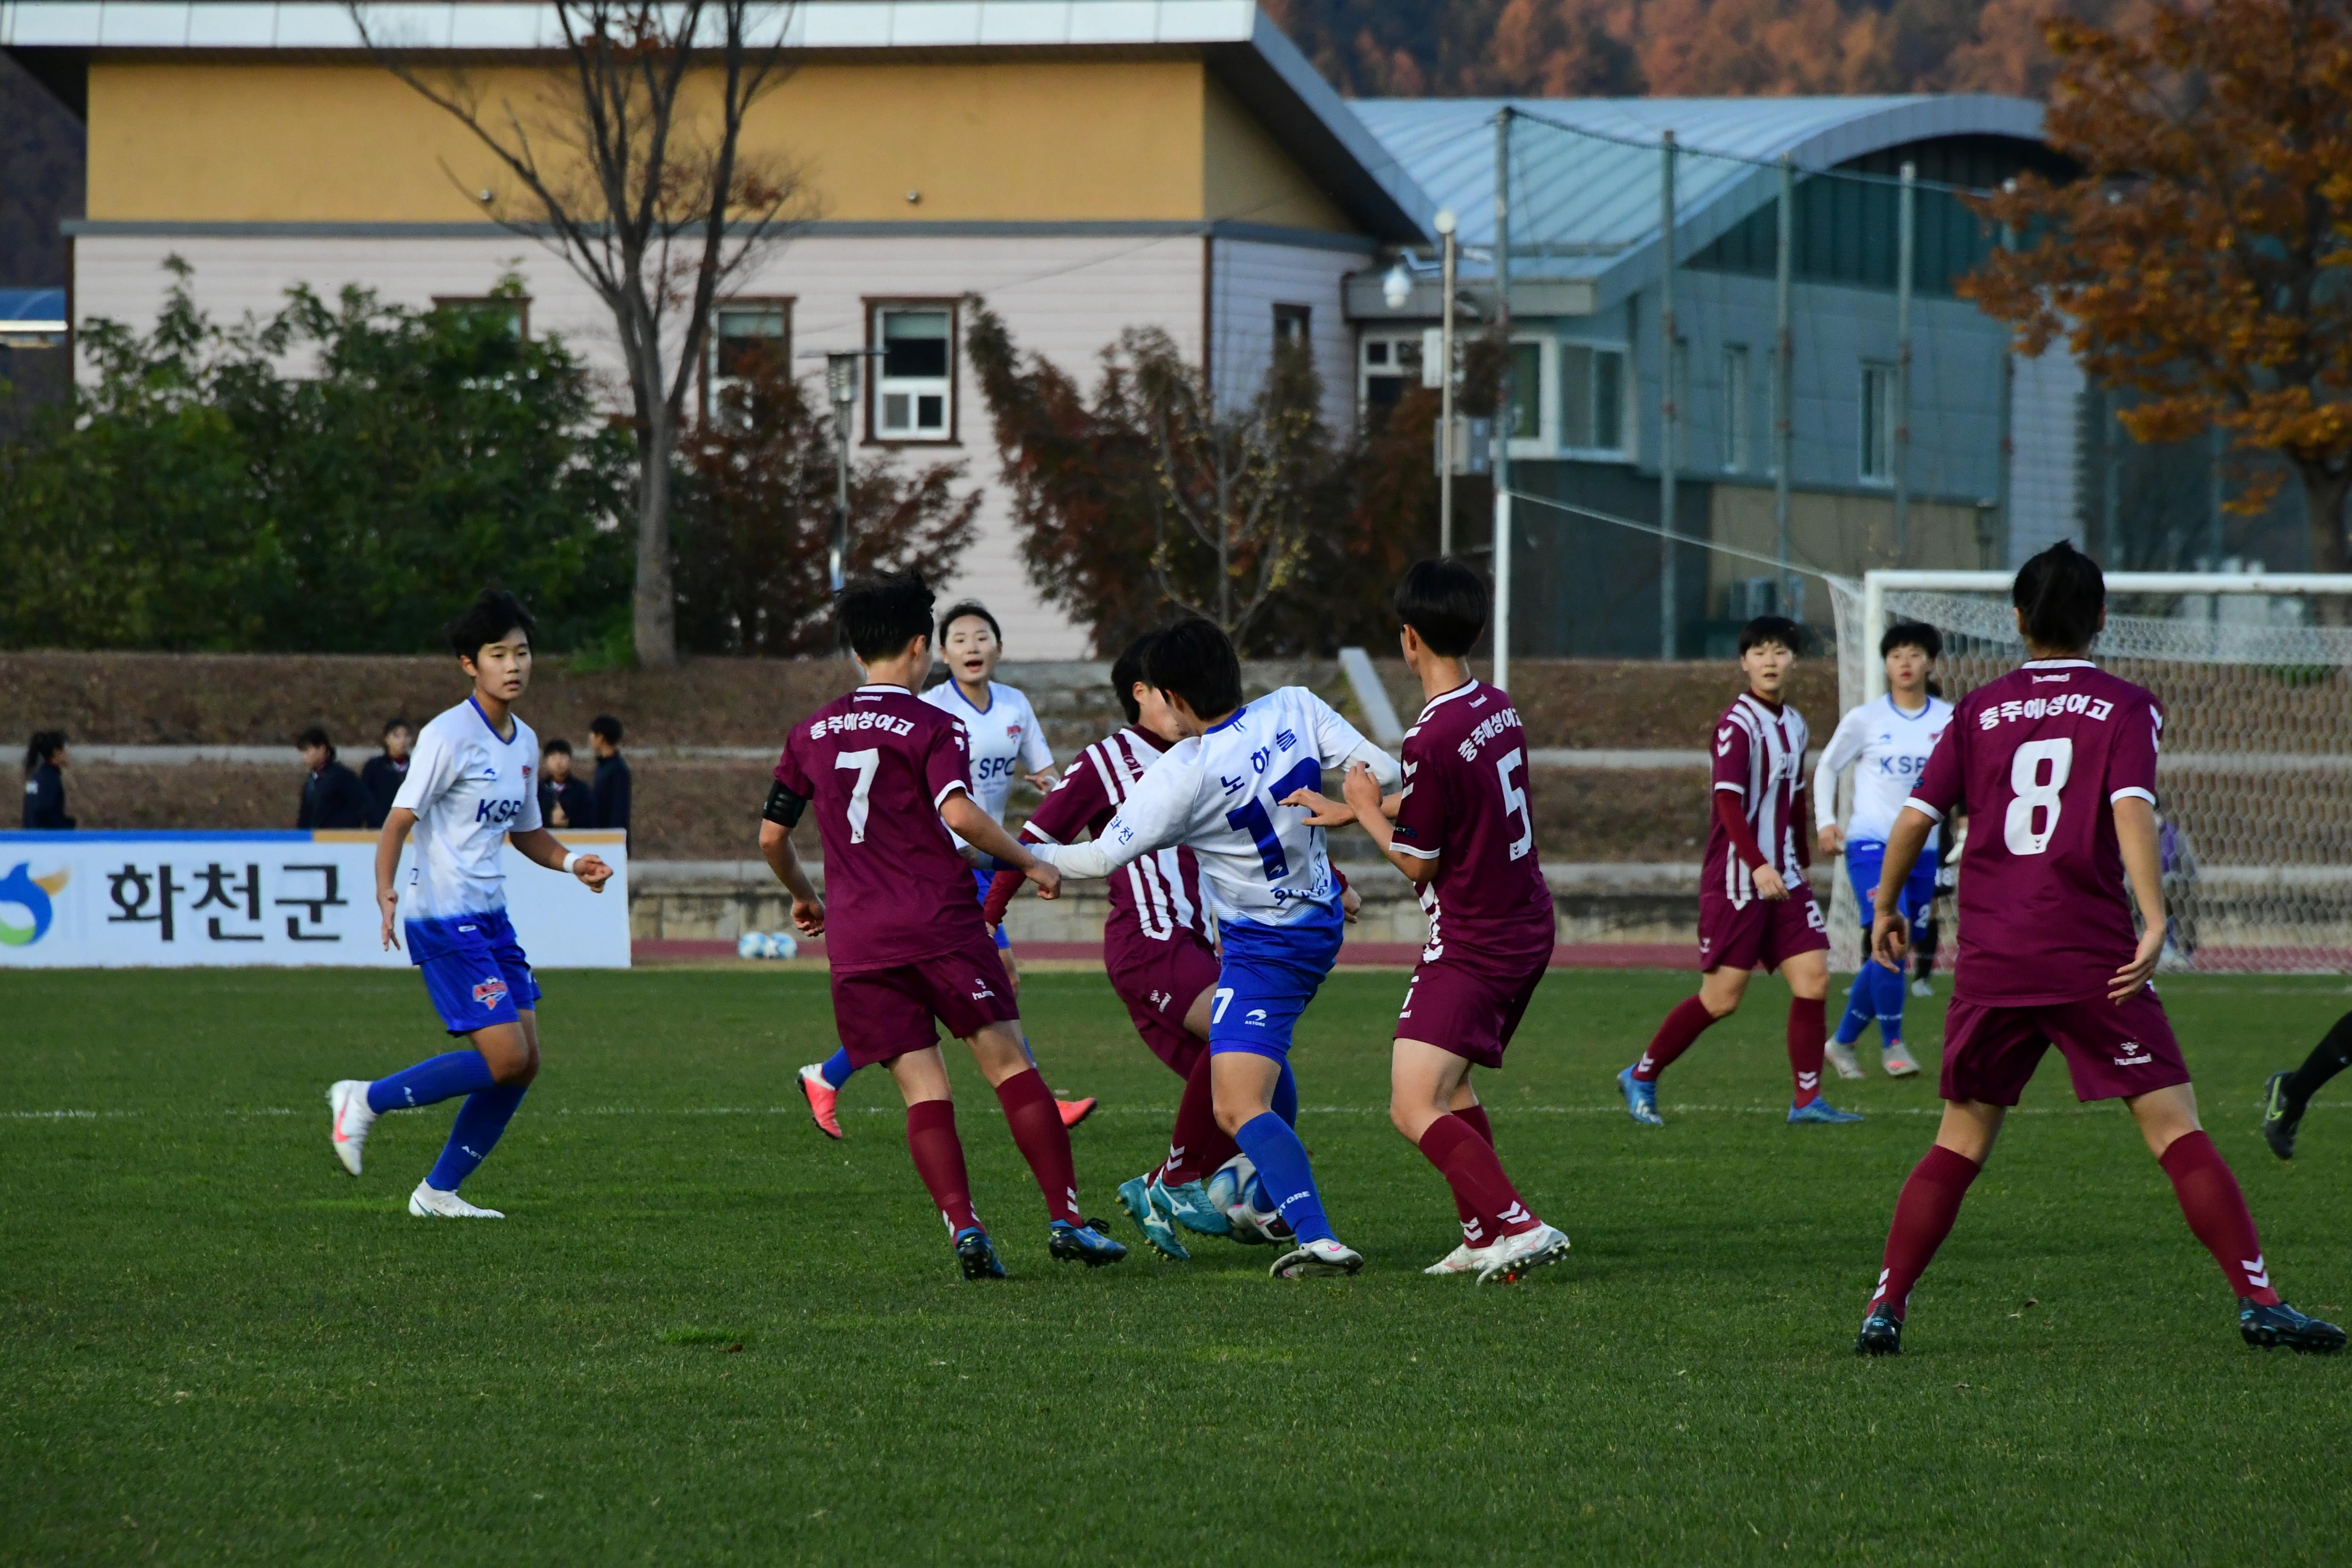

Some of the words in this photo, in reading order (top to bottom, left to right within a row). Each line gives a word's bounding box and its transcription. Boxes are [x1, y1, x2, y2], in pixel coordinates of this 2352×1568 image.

[810, 711, 915, 740] 충주예성여고
[1979, 694, 2114, 730] 충주예성여고
[835, 748, 880, 844] 7
[1225, 757, 1322, 881] 17
[1496, 747, 1532, 861] 5
[2004, 738, 2074, 855] 8
[106, 863, 348, 942] 화천군
[1211, 988, 1234, 1024] 7
